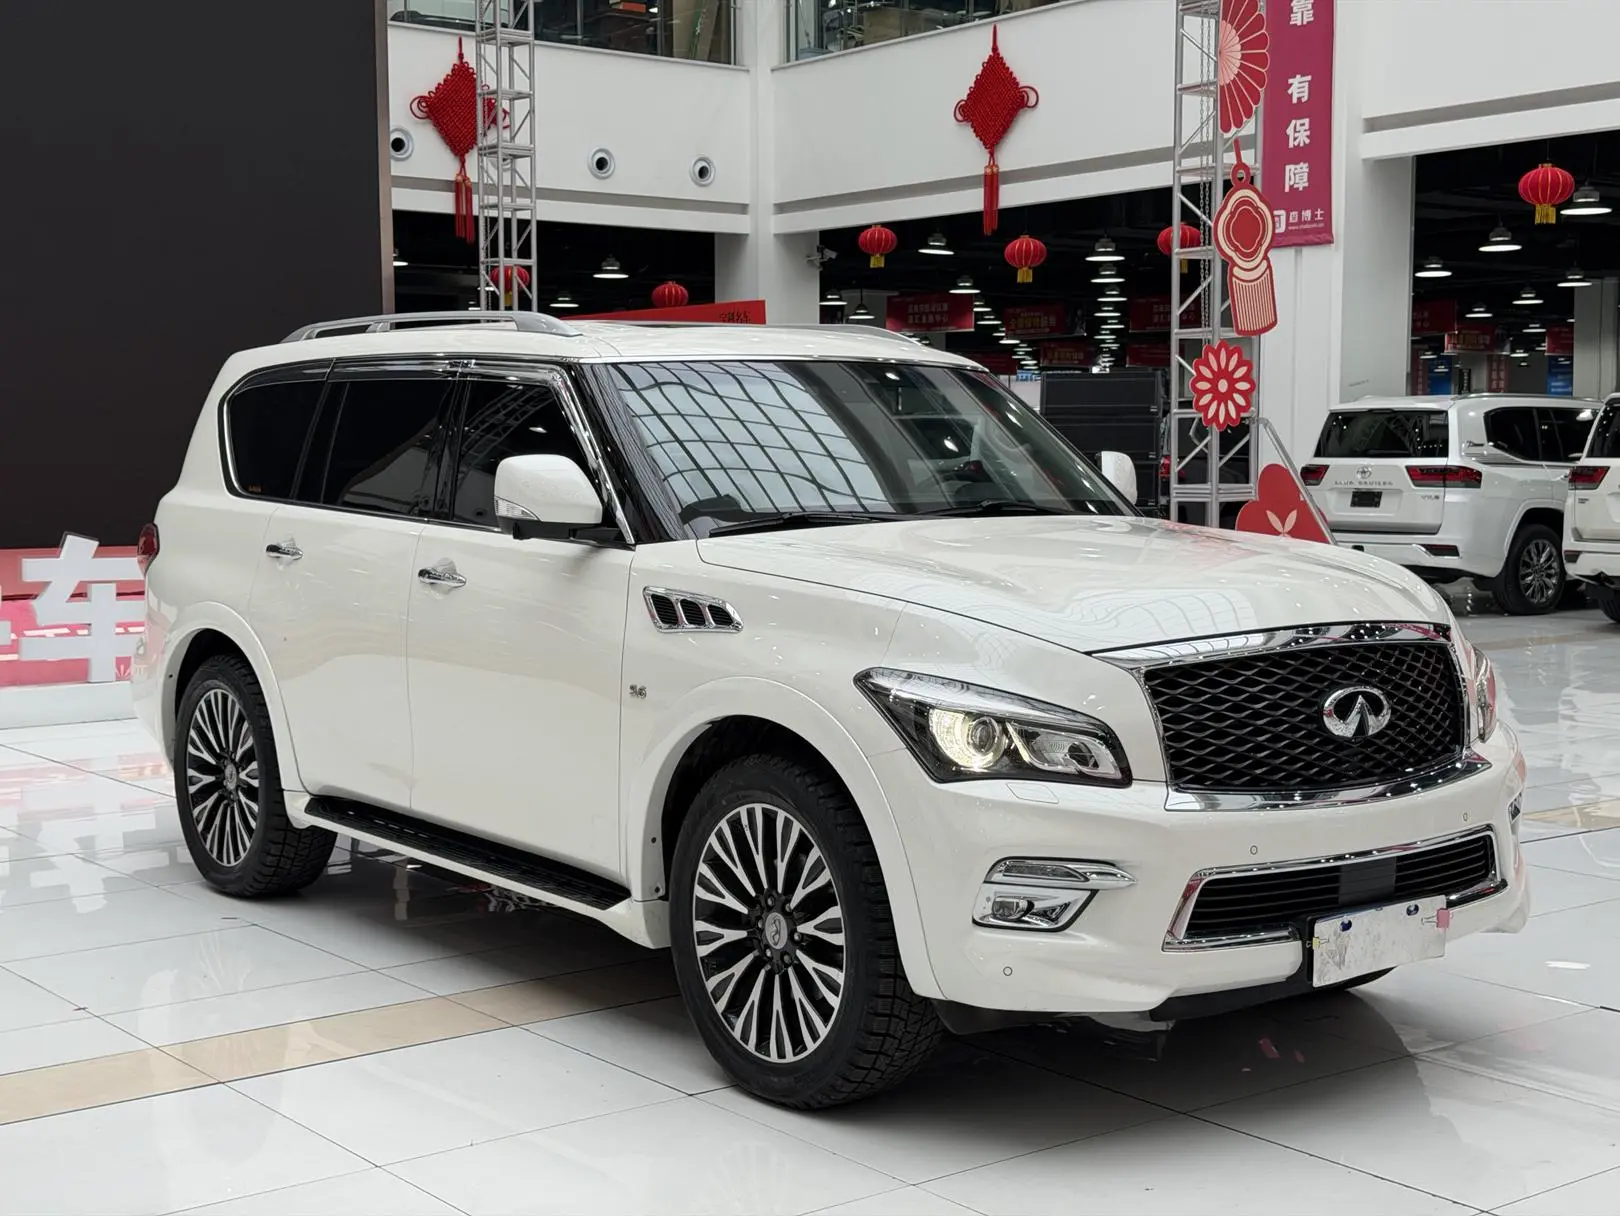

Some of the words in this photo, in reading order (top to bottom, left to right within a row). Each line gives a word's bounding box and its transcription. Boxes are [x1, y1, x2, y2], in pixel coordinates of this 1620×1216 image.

[1284, 74, 1312, 193] 有保障
[0, 534, 146, 683] 车
